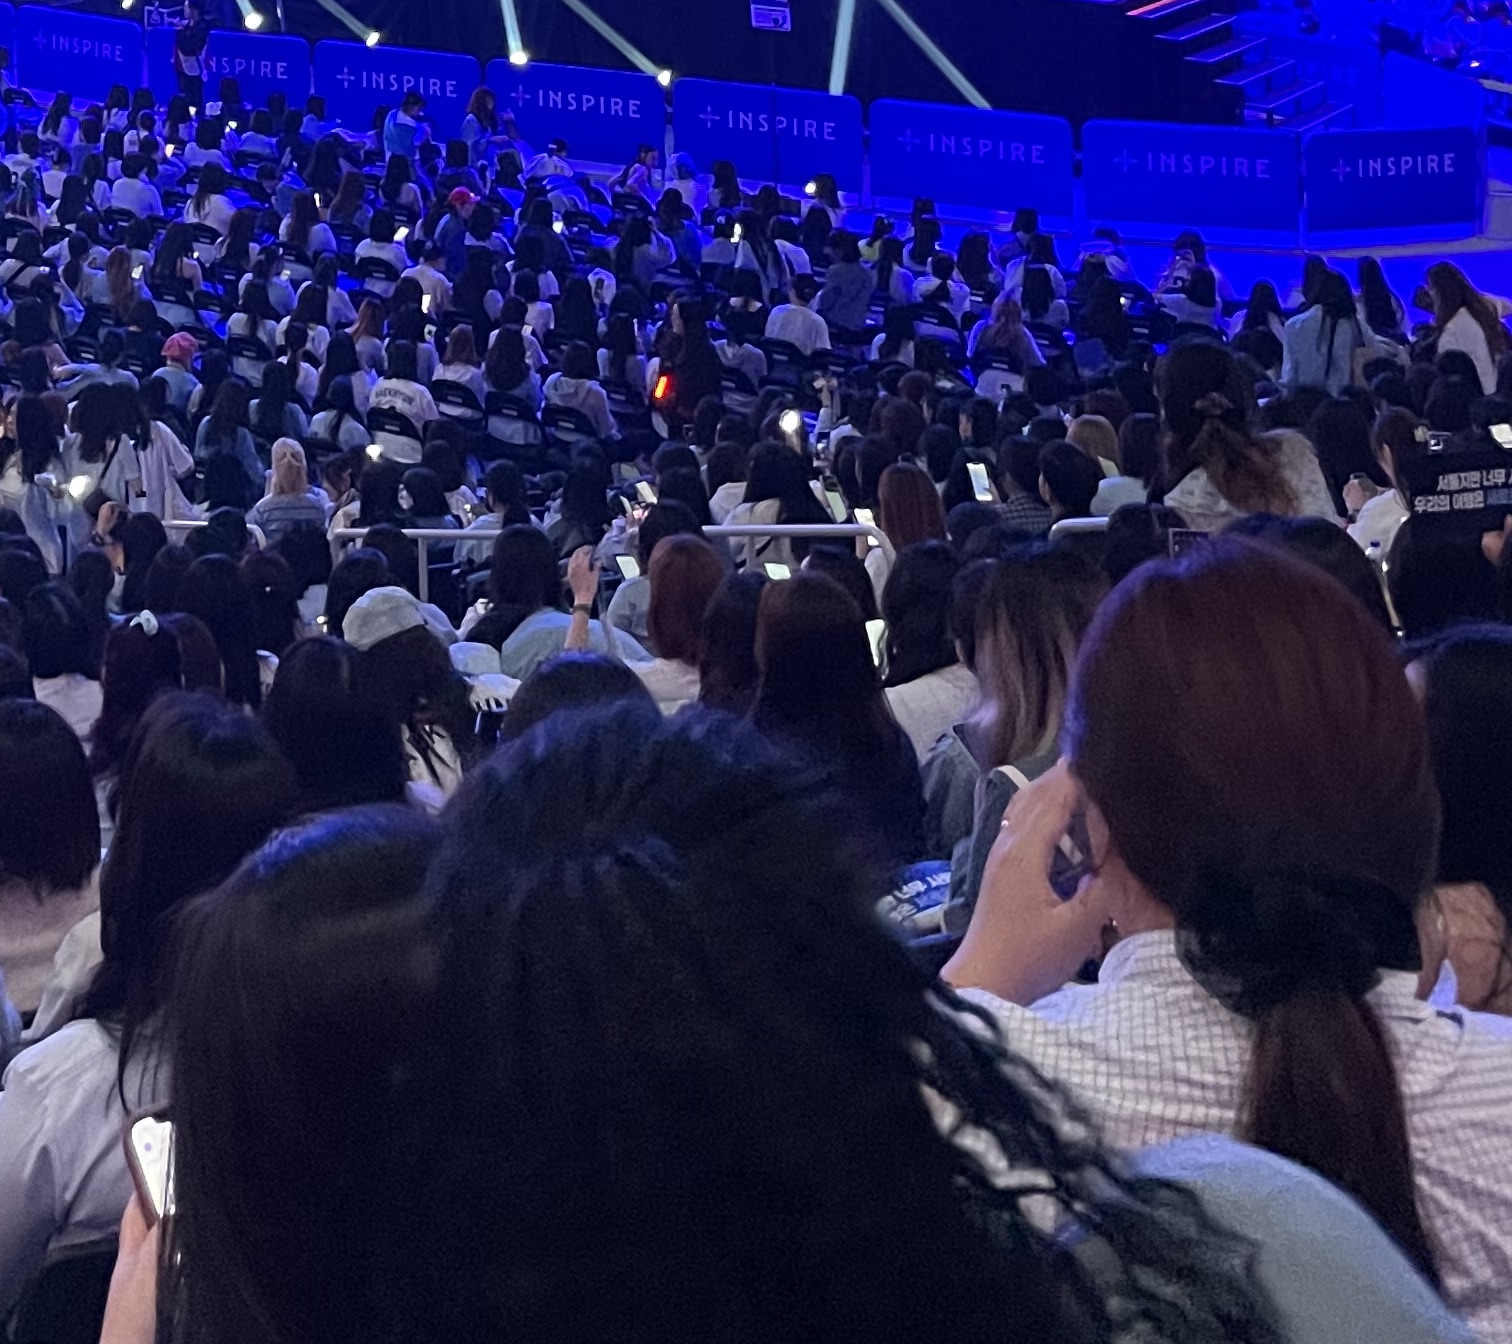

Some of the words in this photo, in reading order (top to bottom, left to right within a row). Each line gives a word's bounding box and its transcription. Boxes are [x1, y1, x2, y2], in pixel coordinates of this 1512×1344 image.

[52, 34, 124, 62] INSPIRE
[361, 70, 458, 98] INSPIRE
[538, 88, 641, 119] INSPIRE
[728, 109, 836, 141] INSPIRE
[929, 132, 1045, 164] INSPIRE
[1146, 151, 1272, 179] INSPIRE
[1358, 152, 1455, 179] INSPIRE
